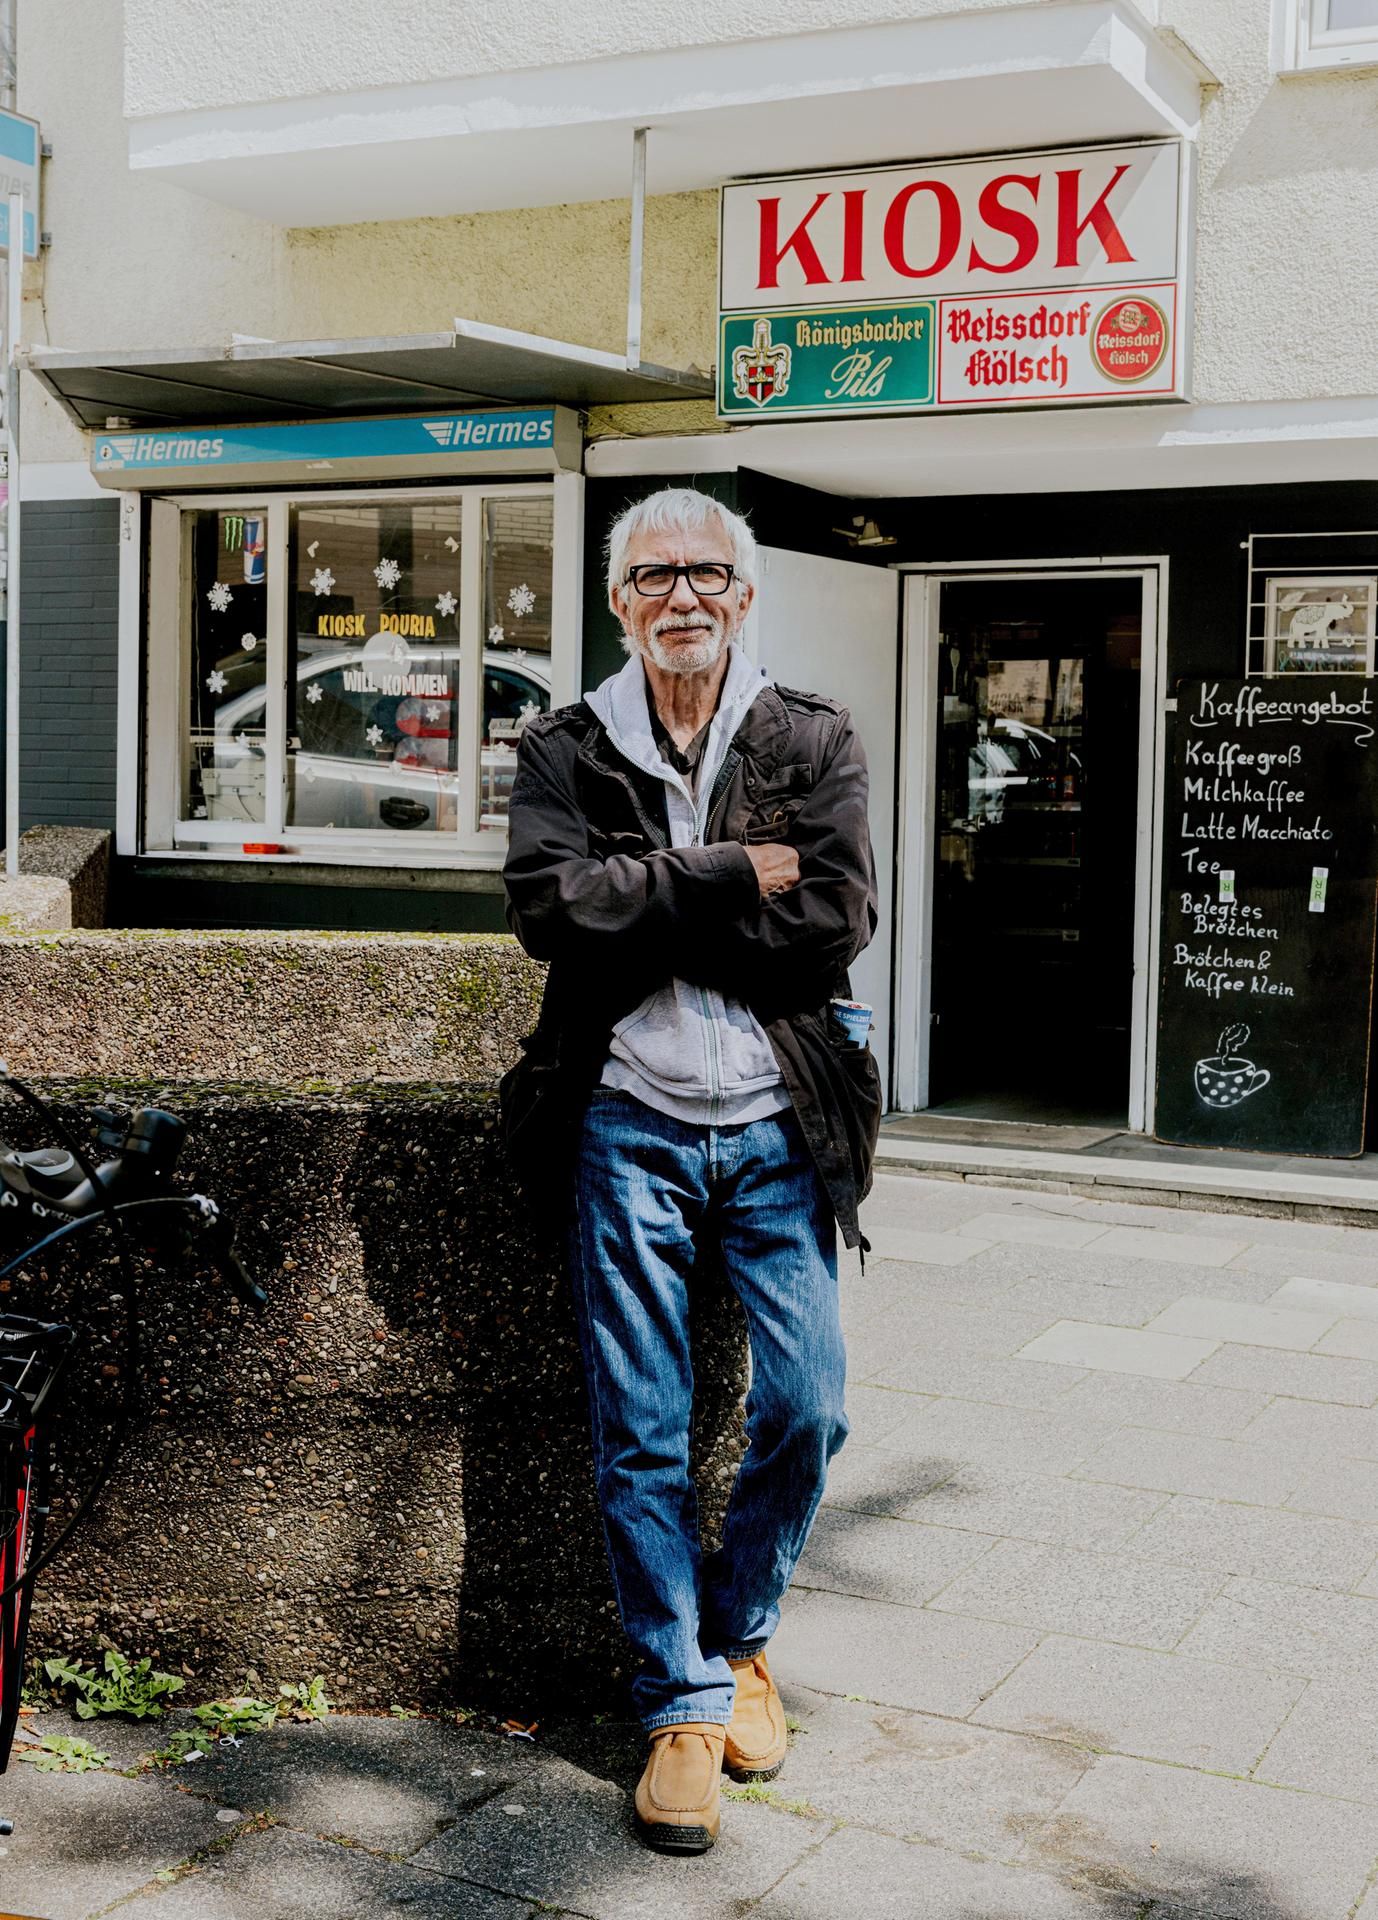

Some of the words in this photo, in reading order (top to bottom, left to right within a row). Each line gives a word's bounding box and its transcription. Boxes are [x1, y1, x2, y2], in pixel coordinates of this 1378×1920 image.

[755, 165, 1137, 289] KIOSK
[796, 316, 925, 351] Königsbacher
[947, 301, 1091, 344] Reissdorf
[1098, 331, 1161, 349] Reissdorf
[964, 345, 1069, 389] Kölsch
[1109, 349, 1149, 365] Kölsch
[824, 348, 893, 399] Pils
[452, 418, 553, 446] Hermes
[135, 437, 224, 460] Hermes
[318, 614, 366, 637] KIOSK
[380, 613, 436, 638] POURIA
[342, 670, 378, 693] WILL
[381, 673, 448, 697] KOMMEN
[1199, 682, 1373, 727] Kaffeeangebot
[1184, 776, 1305, 812] Milchkaffee
[1181, 812, 1236, 839] Latte
[1241, 814, 1333, 840] Macchiato
[1181, 847, 1221, 874] Tee
[1180, 892, 1263, 923] Belegtes
[1193, 914, 1280, 940] Brötchen
[1184, 968, 1244, 999] Kaffee
